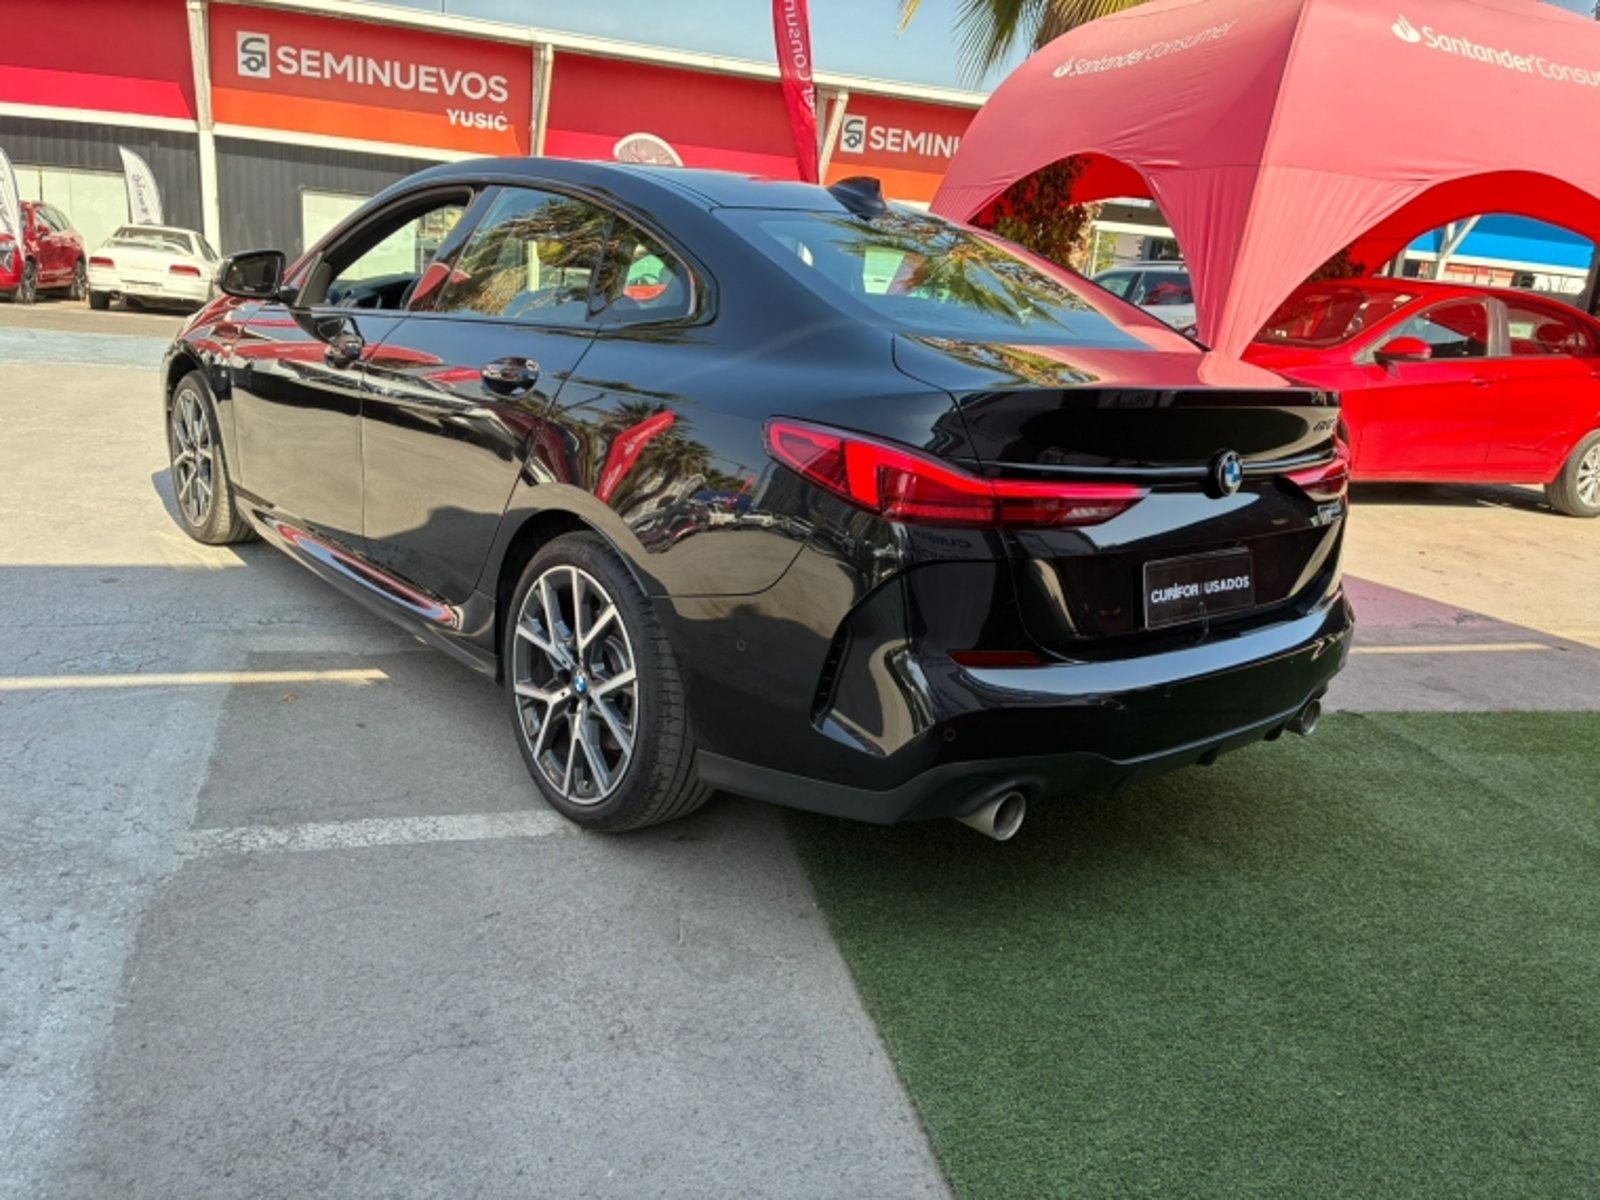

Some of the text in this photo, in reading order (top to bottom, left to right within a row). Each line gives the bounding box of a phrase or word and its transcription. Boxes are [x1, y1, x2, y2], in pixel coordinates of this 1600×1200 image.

[276, 46, 509, 103] SEMINUEVOS
[1069, 19, 1239, 77] Santander Consumer
[1422, 25, 1534, 74] Santander
[1204, 575, 1250, 594] USADOS
